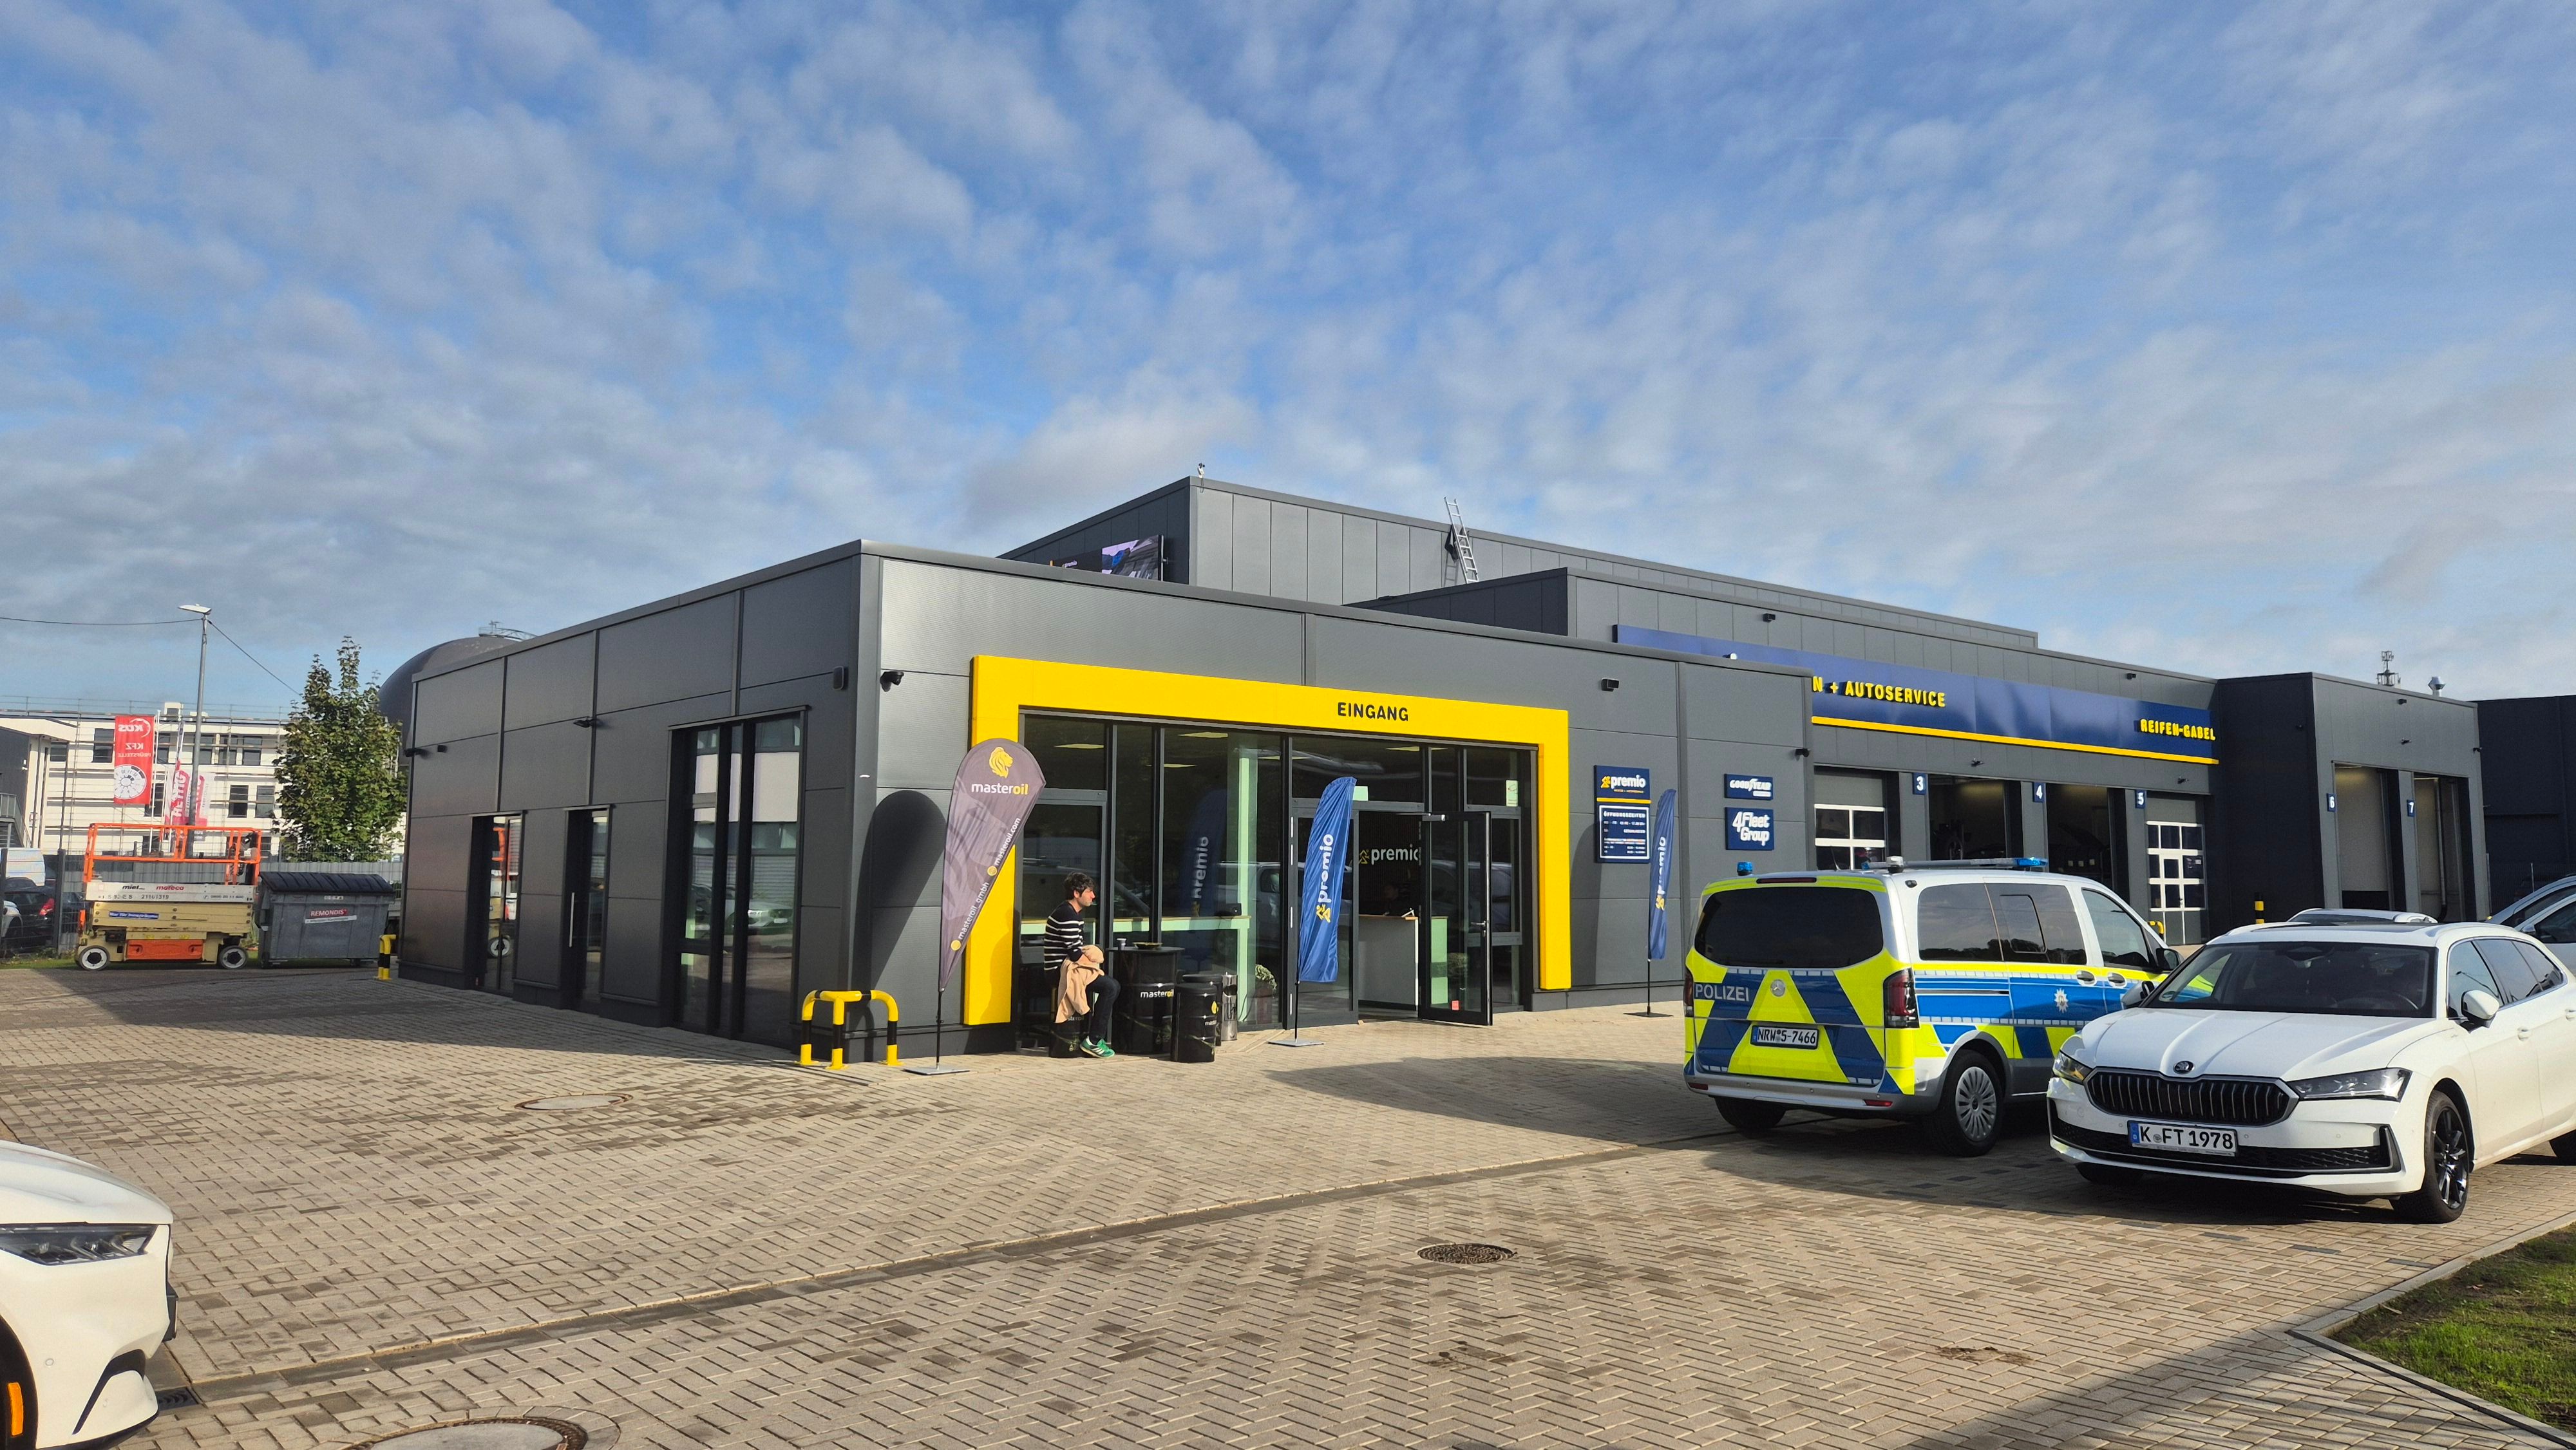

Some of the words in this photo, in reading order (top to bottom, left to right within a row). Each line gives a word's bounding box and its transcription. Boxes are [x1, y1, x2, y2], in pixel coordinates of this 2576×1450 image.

[1845, 681, 1946, 707] AUTOSERVICE
[1338, 702, 1408, 722] EINGANG
[2140, 719, 2216, 740] REIFEN-GABEL
[971, 783, 1028, 795] masteroil
[1611, 775, 1647, 789] premio
[1729, 778, 1772, 792] GOODYEAR
[1916, 776, 1924, 791] 3
[2036, 785, 2043, 800] 4
[2137, 792, 2144, 805] 5
[2330, 796, 2335, 809] 6
[1732, 811, 1770, 833] 4Fleet
[994, 817, 1021, 866] masteroil.com
[1740, 827, 1770, 847] Group
[1318, 834, 1334, 903] premio
[1695, 984, 1749, 1002] POLIZEI
[1757, 1028, 1777, 1042] NRW
[1781, 1030, 1816, 1044] 5-7466
[2140, 1125, 2151, 1142] K
[2162, 1128, 2184, 1145] FT
[2189, 1131, 2233, 1149] 1978
